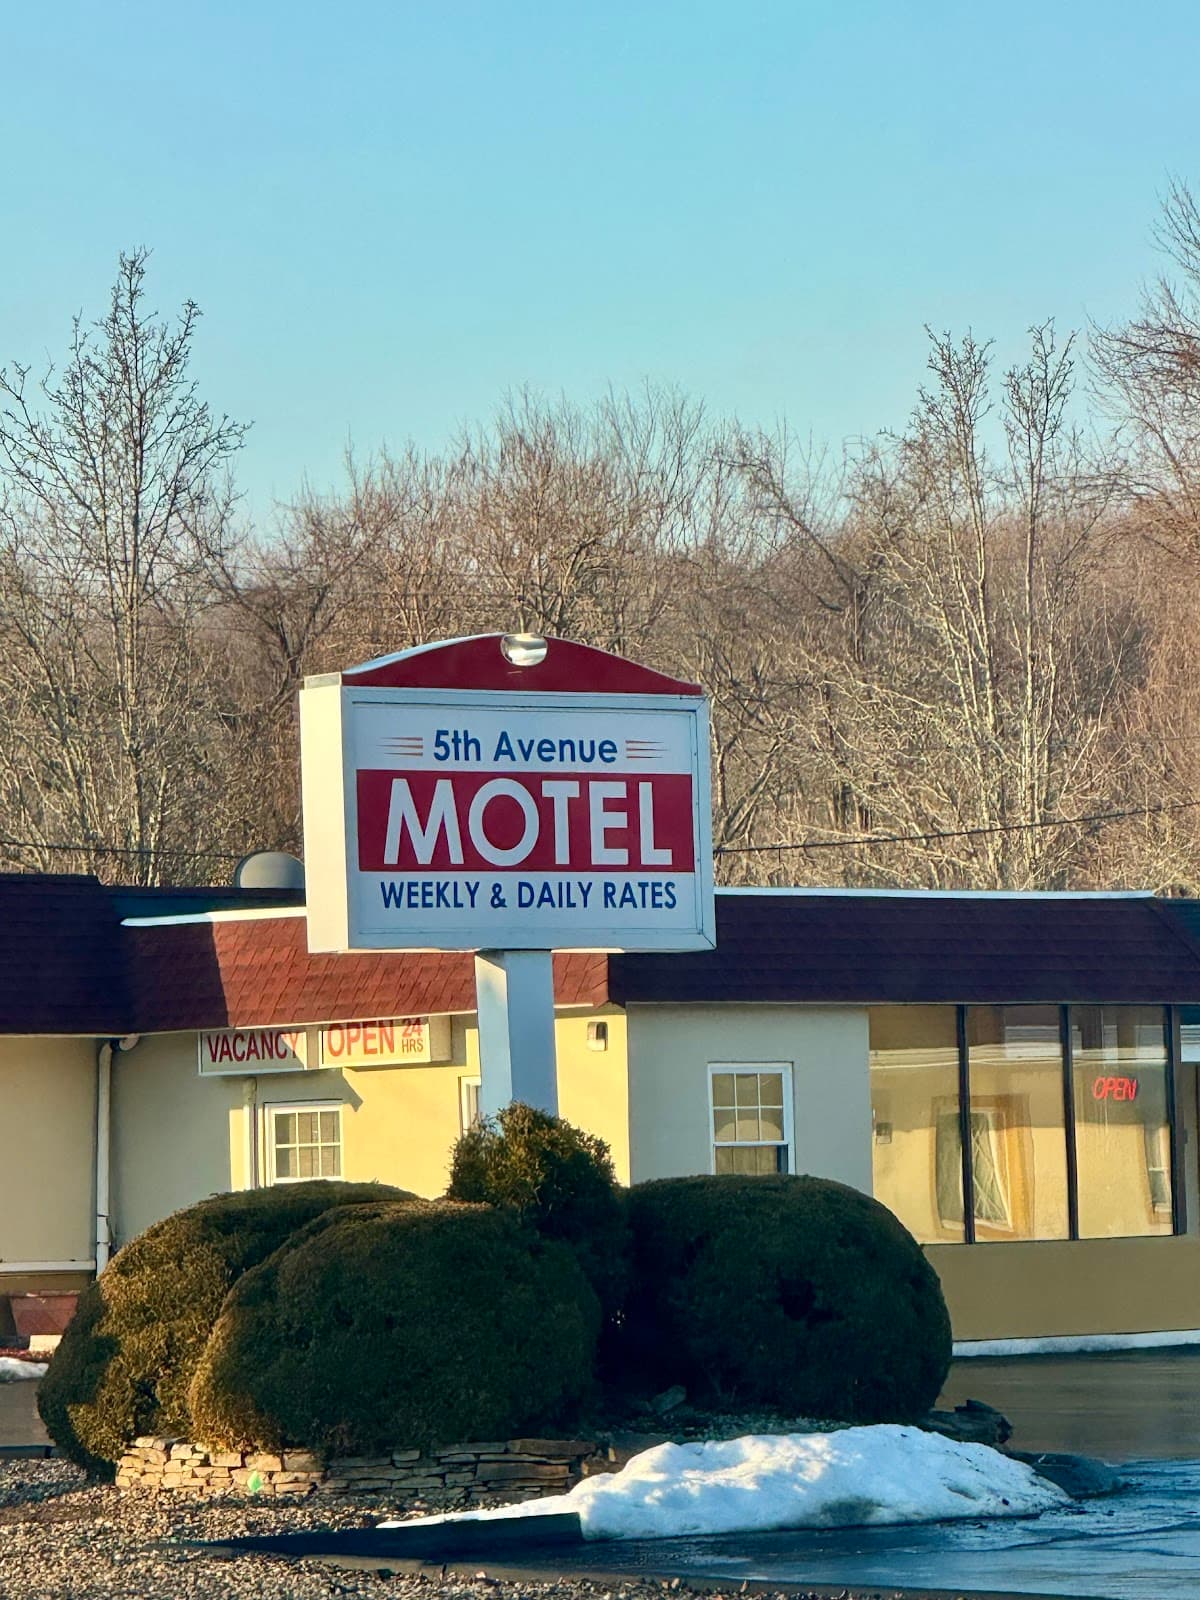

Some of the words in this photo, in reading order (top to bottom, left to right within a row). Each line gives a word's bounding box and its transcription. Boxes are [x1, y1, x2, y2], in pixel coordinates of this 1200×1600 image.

[433, 729, 481, 761] 5th
[493, 730, 618, 763] Avenue
[383, 778, 673, 867] MOTEL
[380, 881, 480, 909] WEEKLY
[491, 881, 507, 909] &
[518, 881, 593, 909] DAILY
[603, 881, 677, 909] RATES
[207, 1031, 299, 1063] VACANCY
[327, 1020, 395, 1057] OPEN
[401, 1018, 423, 1038] 24
[401, 1038, 424, 1053] HRS
[1092, 1076, 1137, 1100] OPEN
